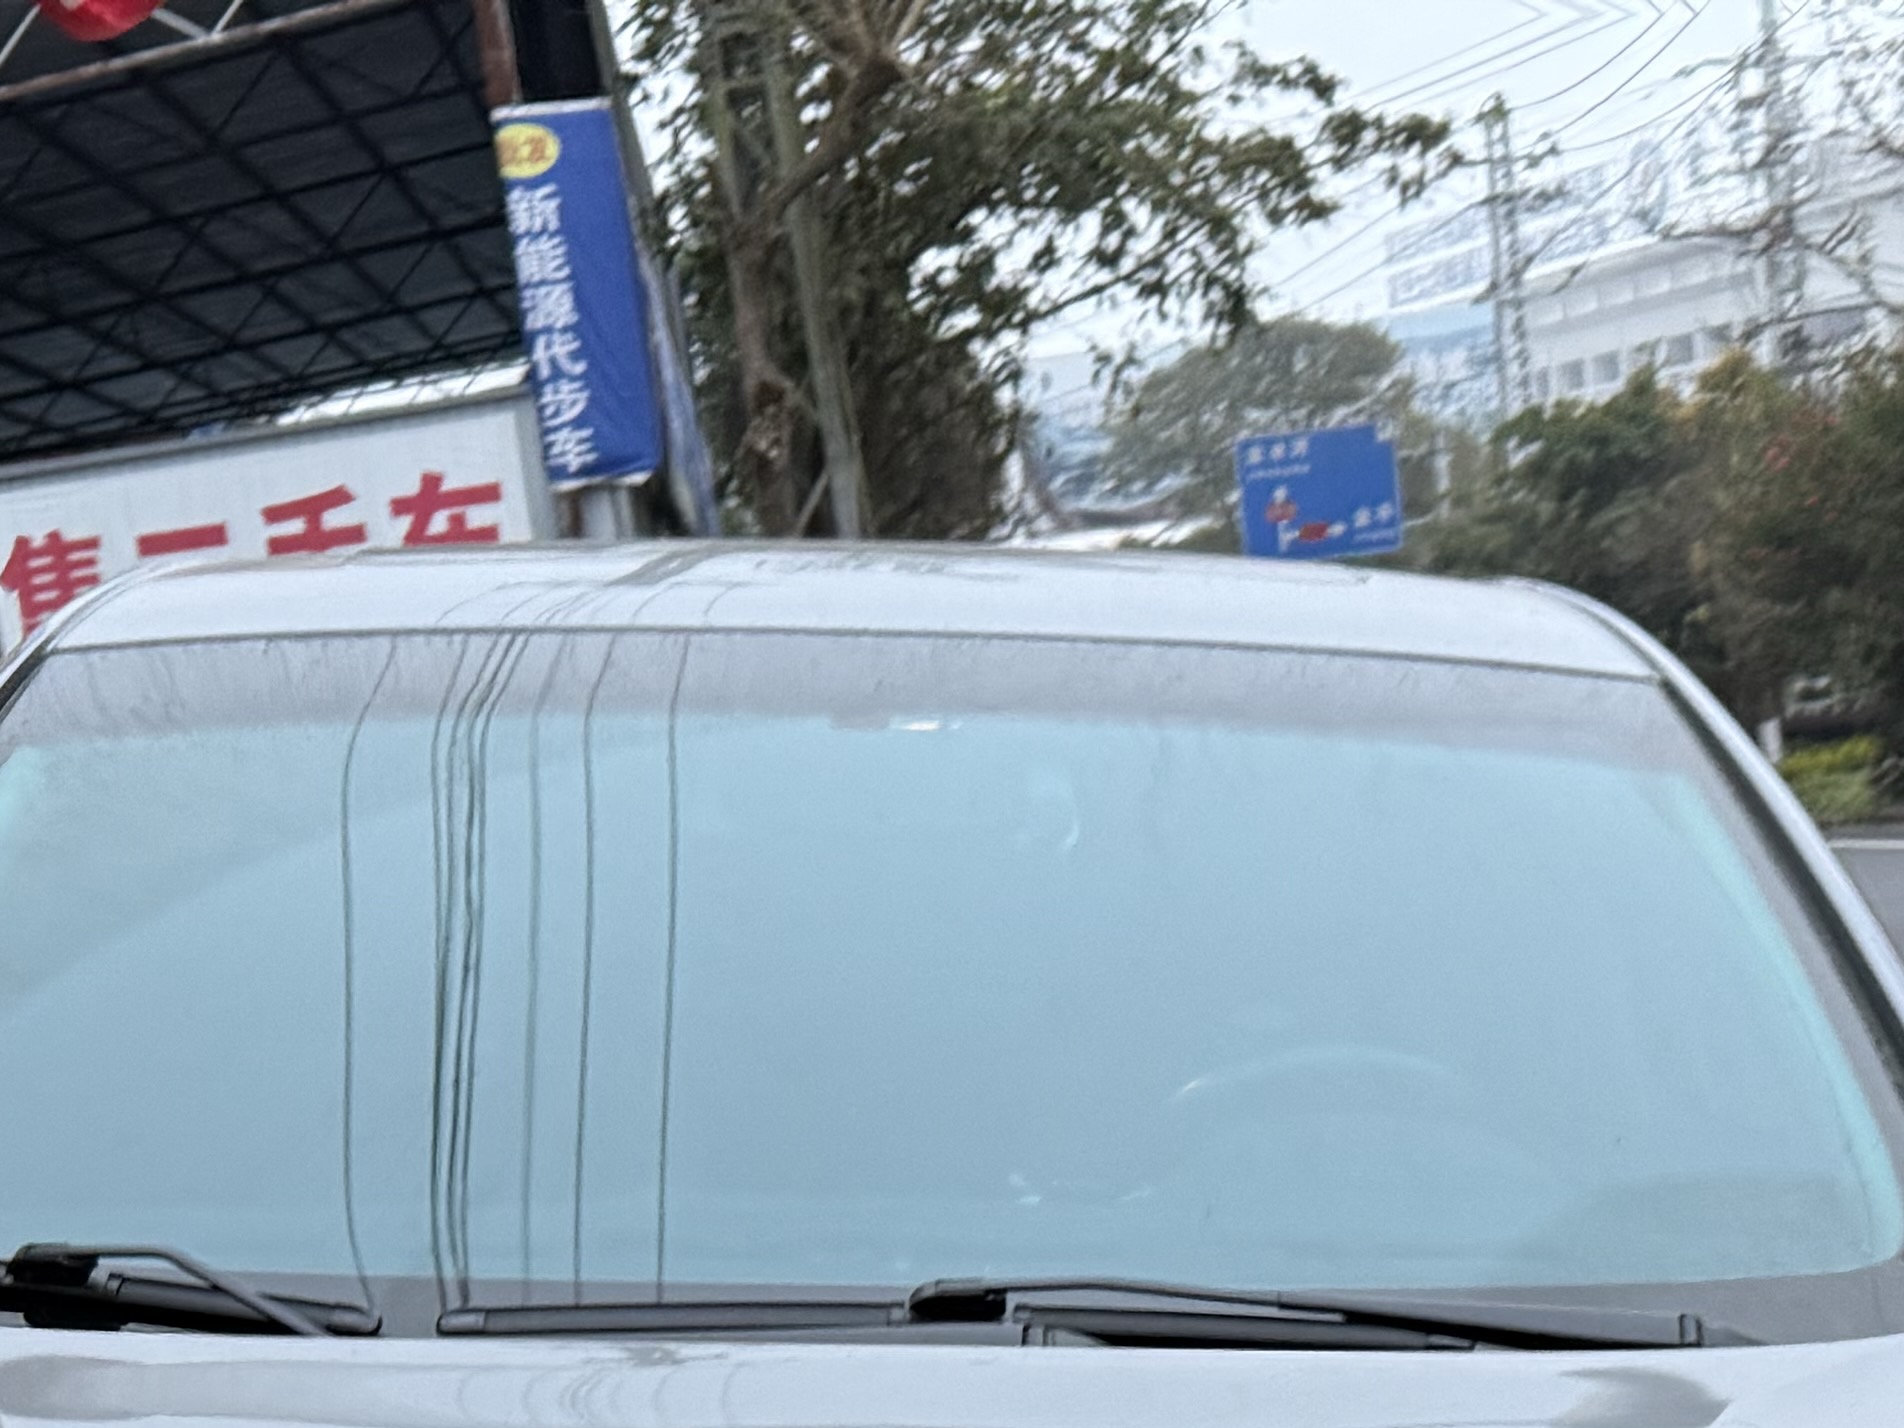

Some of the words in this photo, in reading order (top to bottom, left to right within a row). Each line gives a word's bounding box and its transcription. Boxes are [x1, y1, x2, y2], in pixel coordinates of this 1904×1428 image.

[503, 181, 599, 475] 新能源代步车
